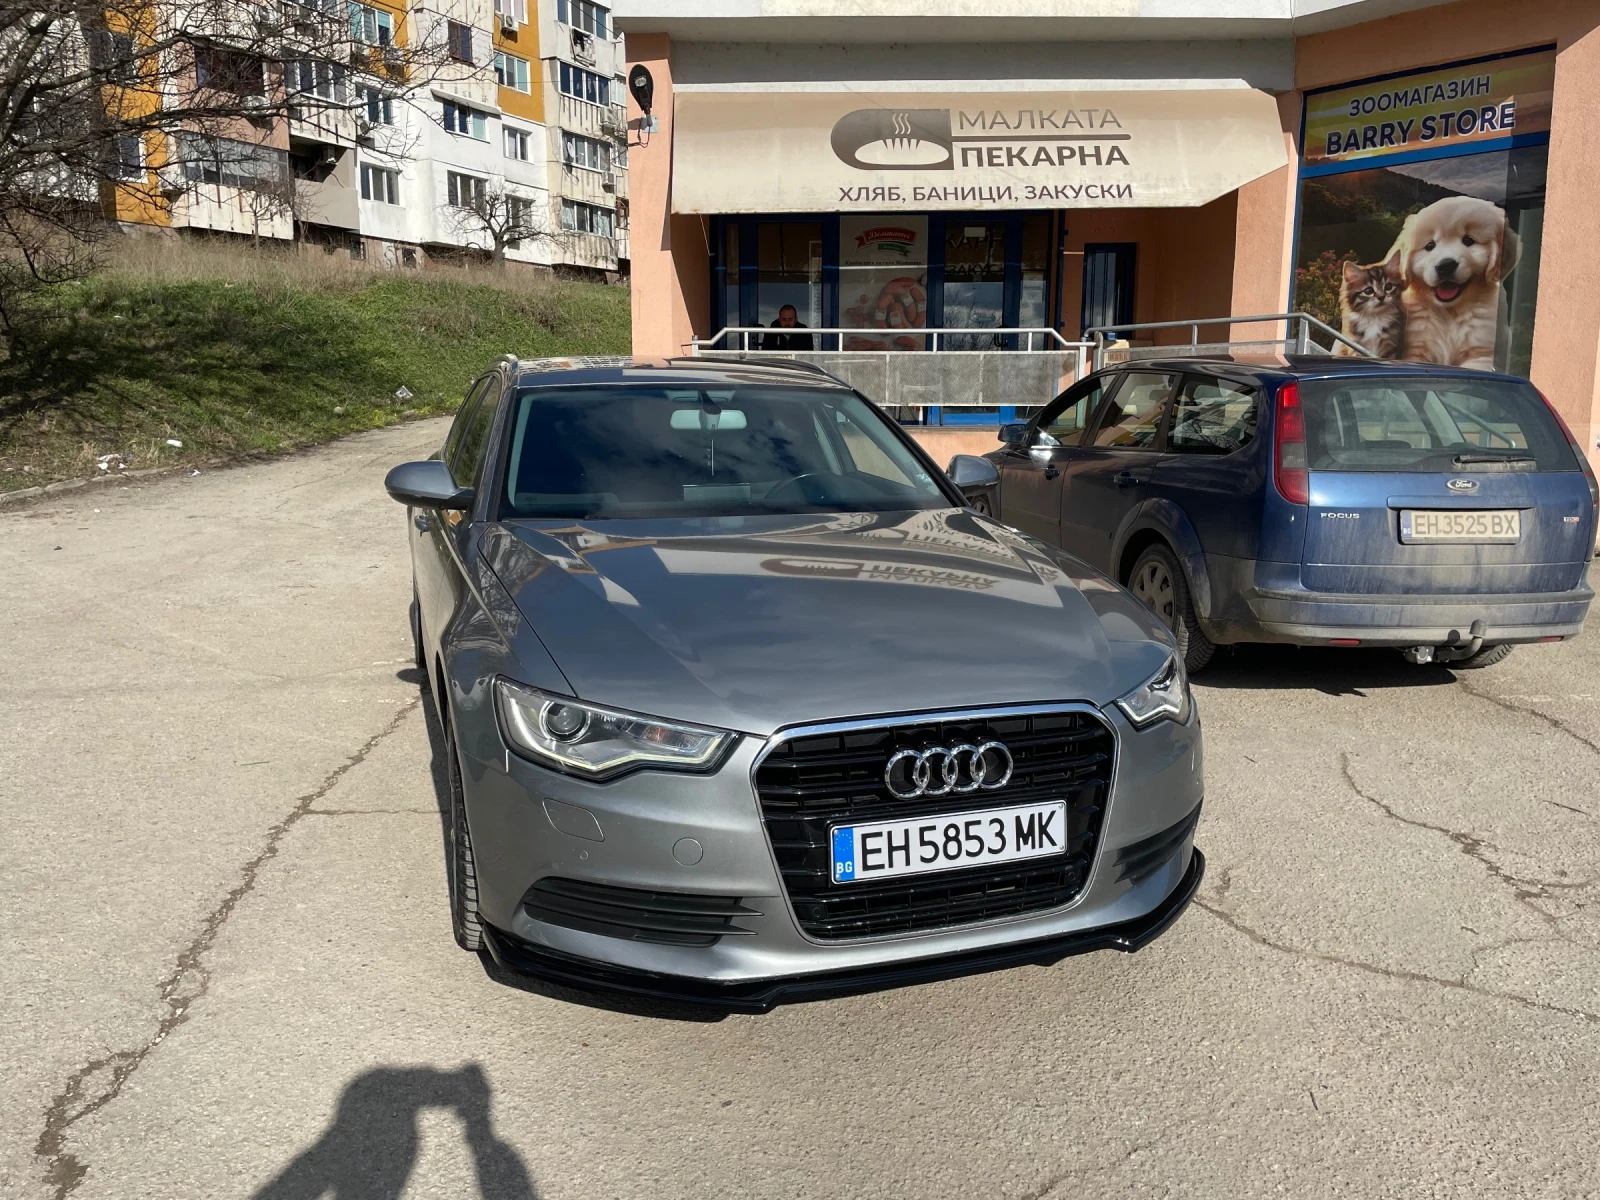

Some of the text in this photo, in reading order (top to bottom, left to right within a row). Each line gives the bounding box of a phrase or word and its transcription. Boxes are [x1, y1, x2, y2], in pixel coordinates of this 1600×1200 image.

[1349, 75, 1491, 117] ЗООМАГАЗИН
[958, 109, 1122, 130] МАЛКАТА
[1326, 102, 1516, 157] BARRY STORE
[961, 145, 1130, 167] ПЕКАРНА
[839, 183, 1133, 204] ХЛЯБ, БАНИЦИ, ЗАКУСКИ
[868, 231, 912, 240] Деликатес
[1455, 477, 1473, 488] Ford
[1014, 810, 1057, 852] MK
[836, 862, 853, 874] BG
